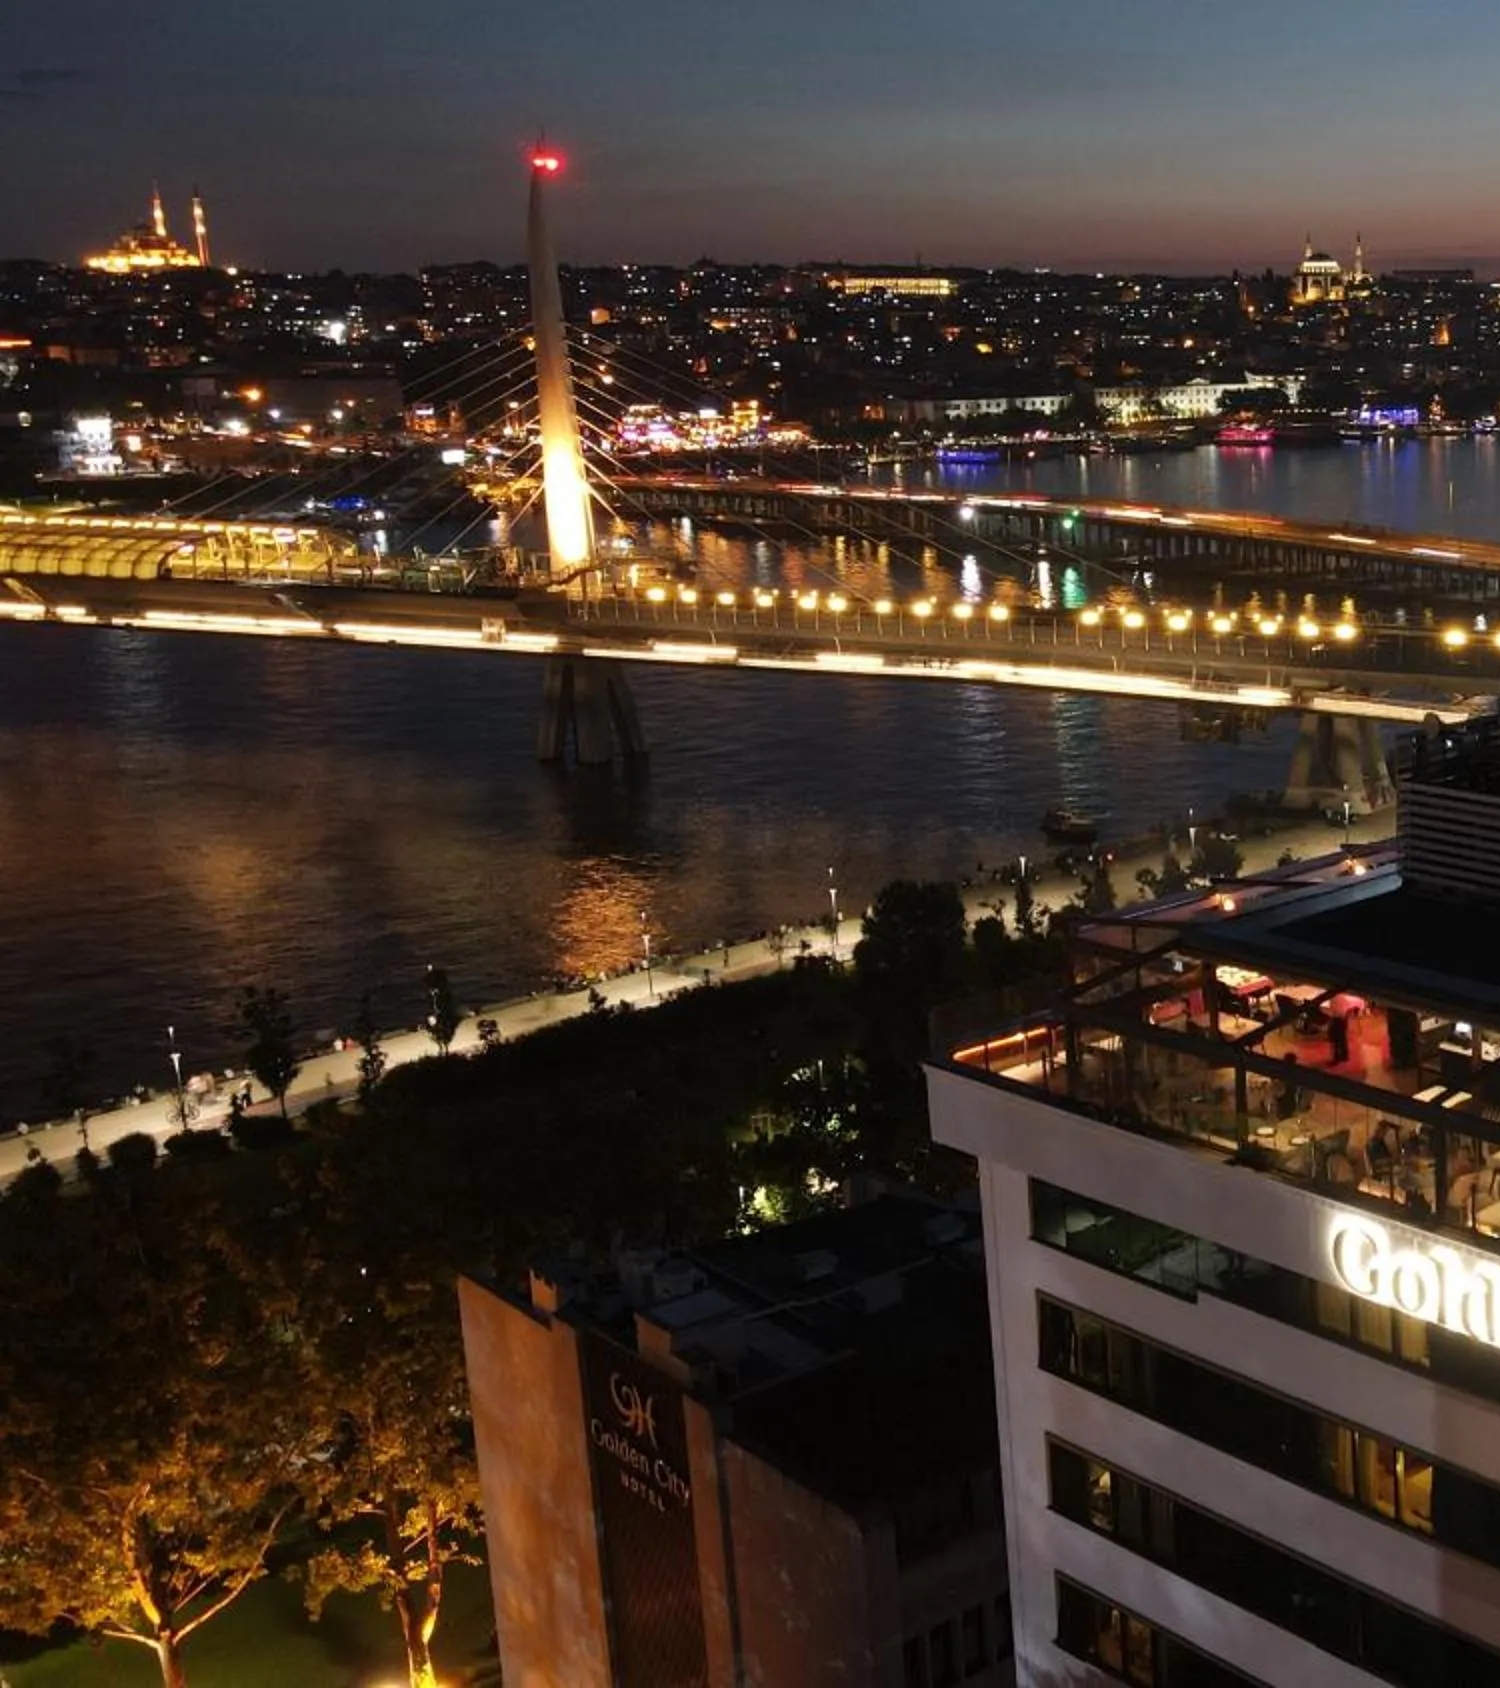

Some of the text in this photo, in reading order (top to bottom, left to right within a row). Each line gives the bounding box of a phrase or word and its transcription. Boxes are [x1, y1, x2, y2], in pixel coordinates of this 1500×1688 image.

[591, 1417, 690, 1508] Golden City
[621, 1469, 667, 1513] HOTEL
